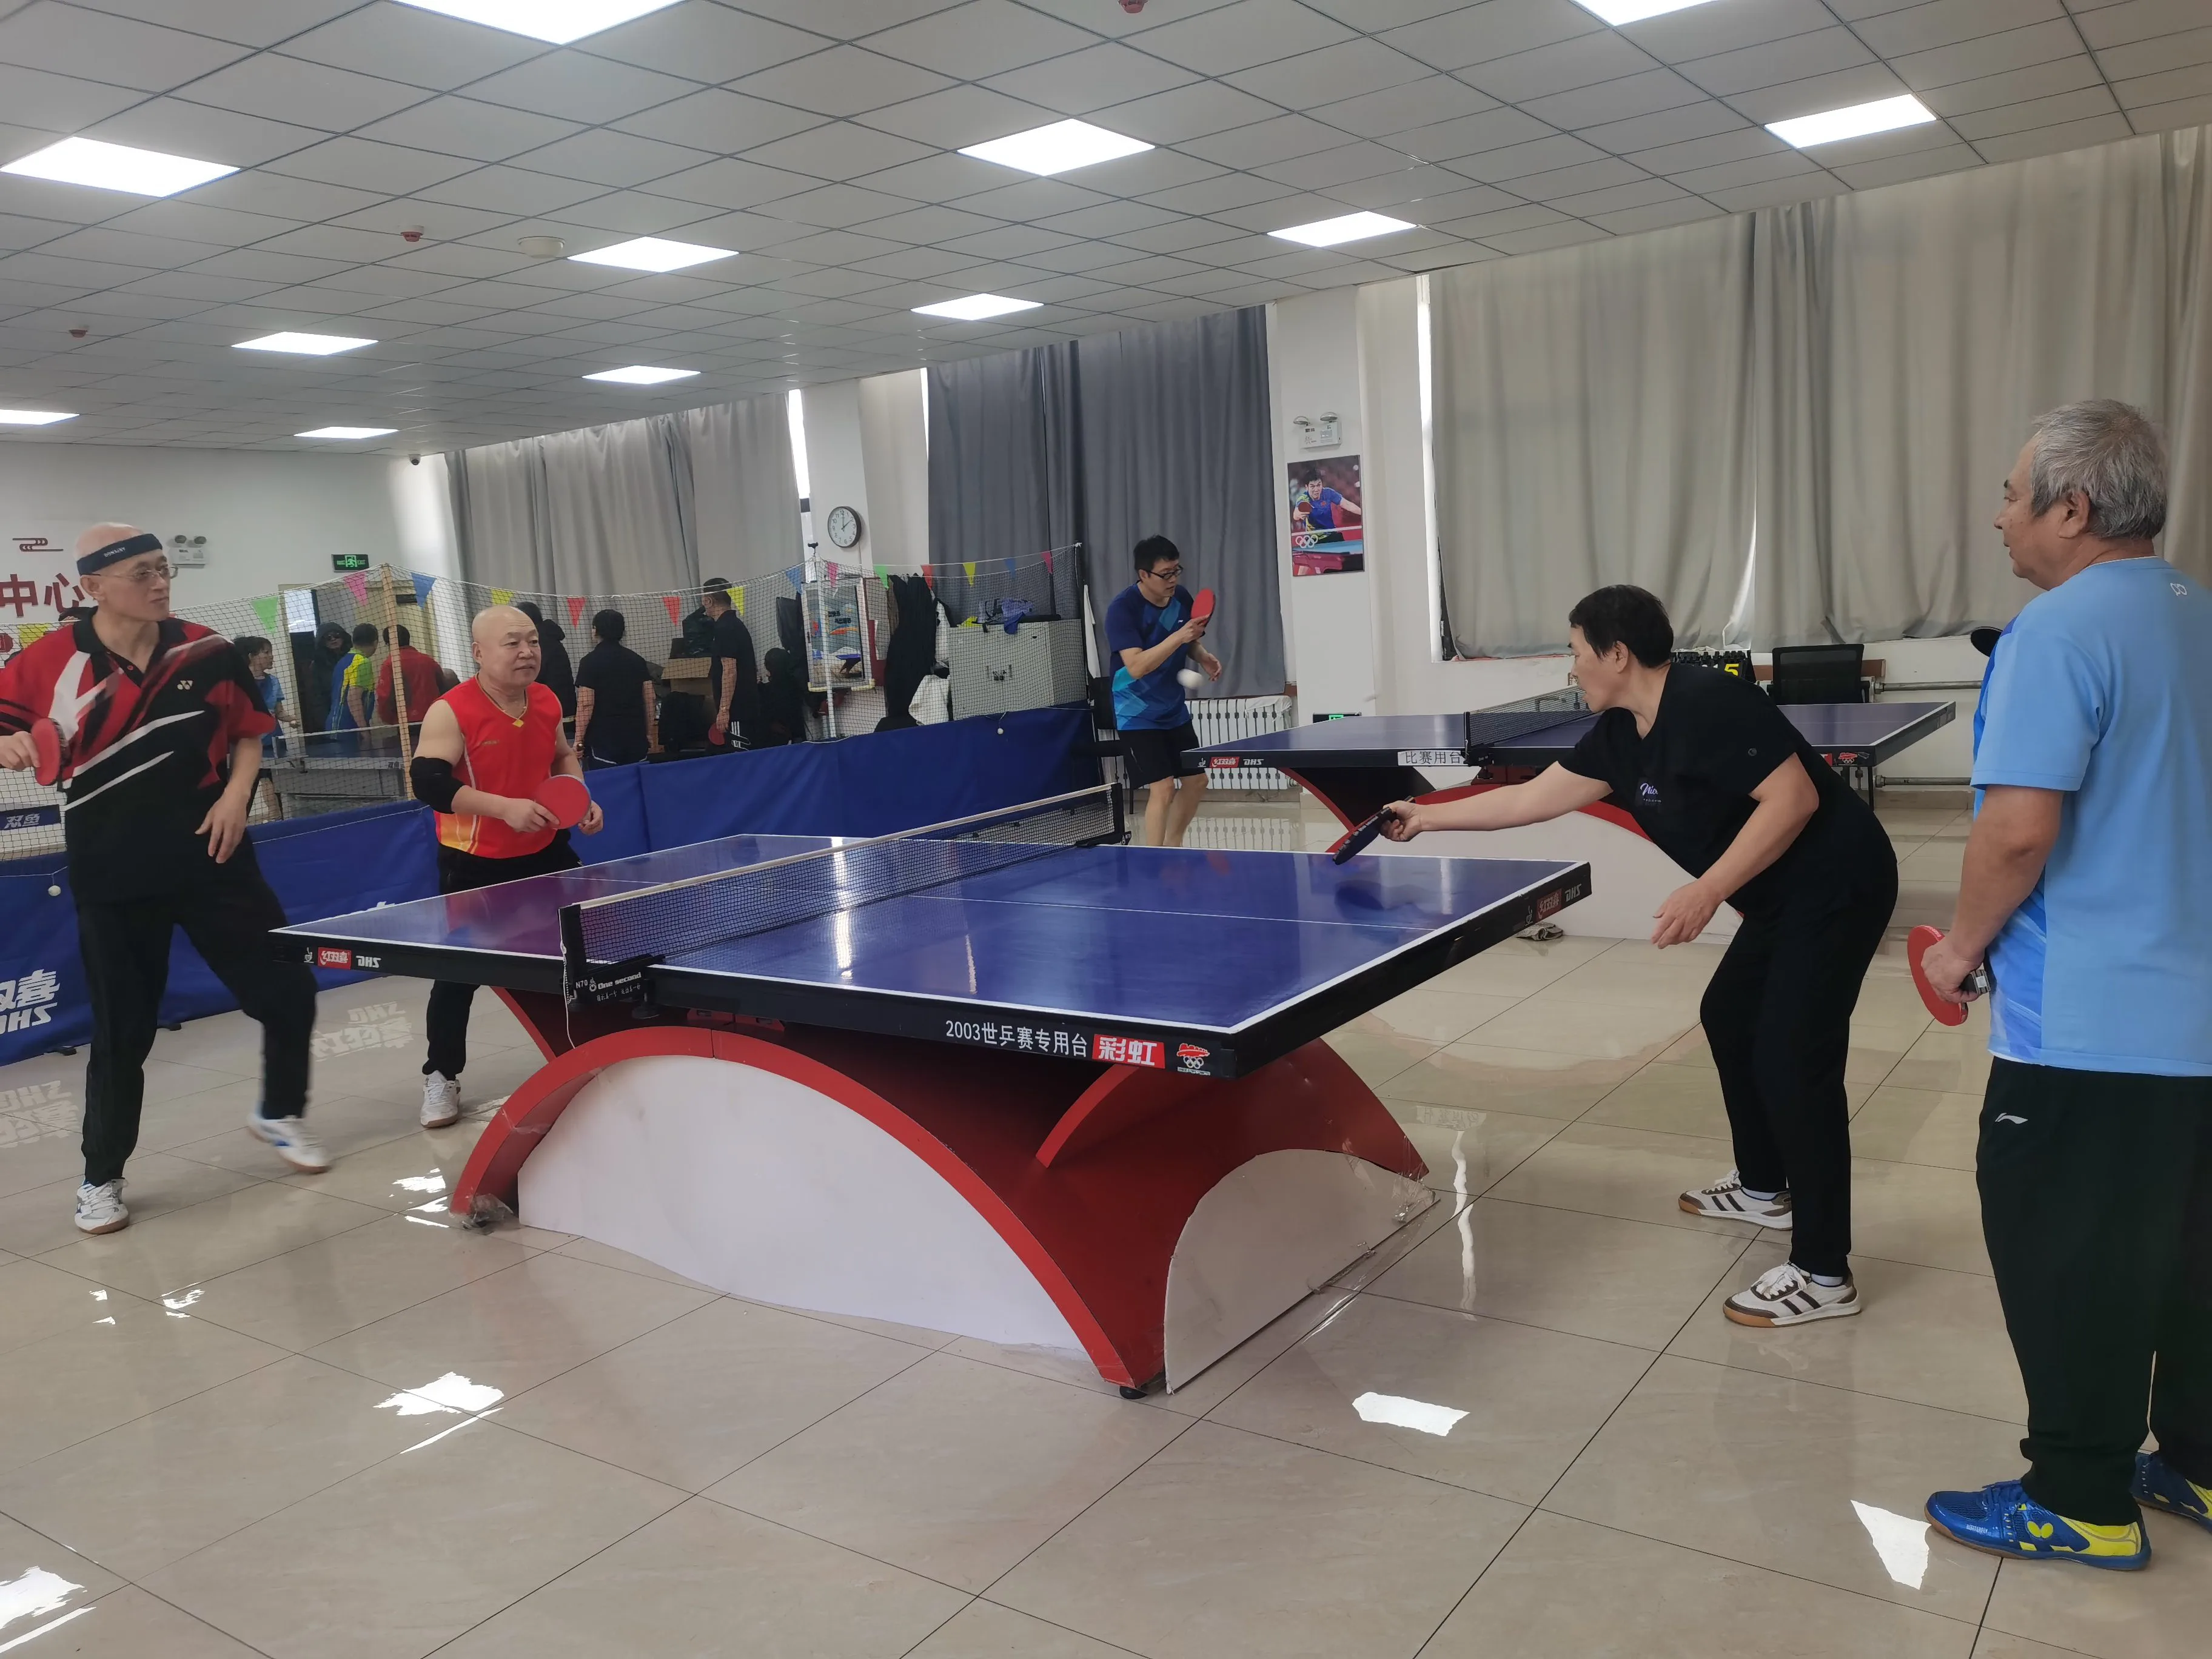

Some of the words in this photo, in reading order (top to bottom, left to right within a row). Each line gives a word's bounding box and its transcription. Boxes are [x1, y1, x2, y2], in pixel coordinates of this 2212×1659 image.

[0, 573, 85, 617] 中心
[1405, 751, 1461, 765] 比赛用台
[1565, 883, 1582, 902] DHS
[356, 955, 382, 968] DHS
[575, 979, 588, 989] N70
[615, 972, 642, 985] second
[945, 1020, 1088, 1057] 2003世乒赛专用台
[1099, 1036, 1158, 1066] 彩虹
